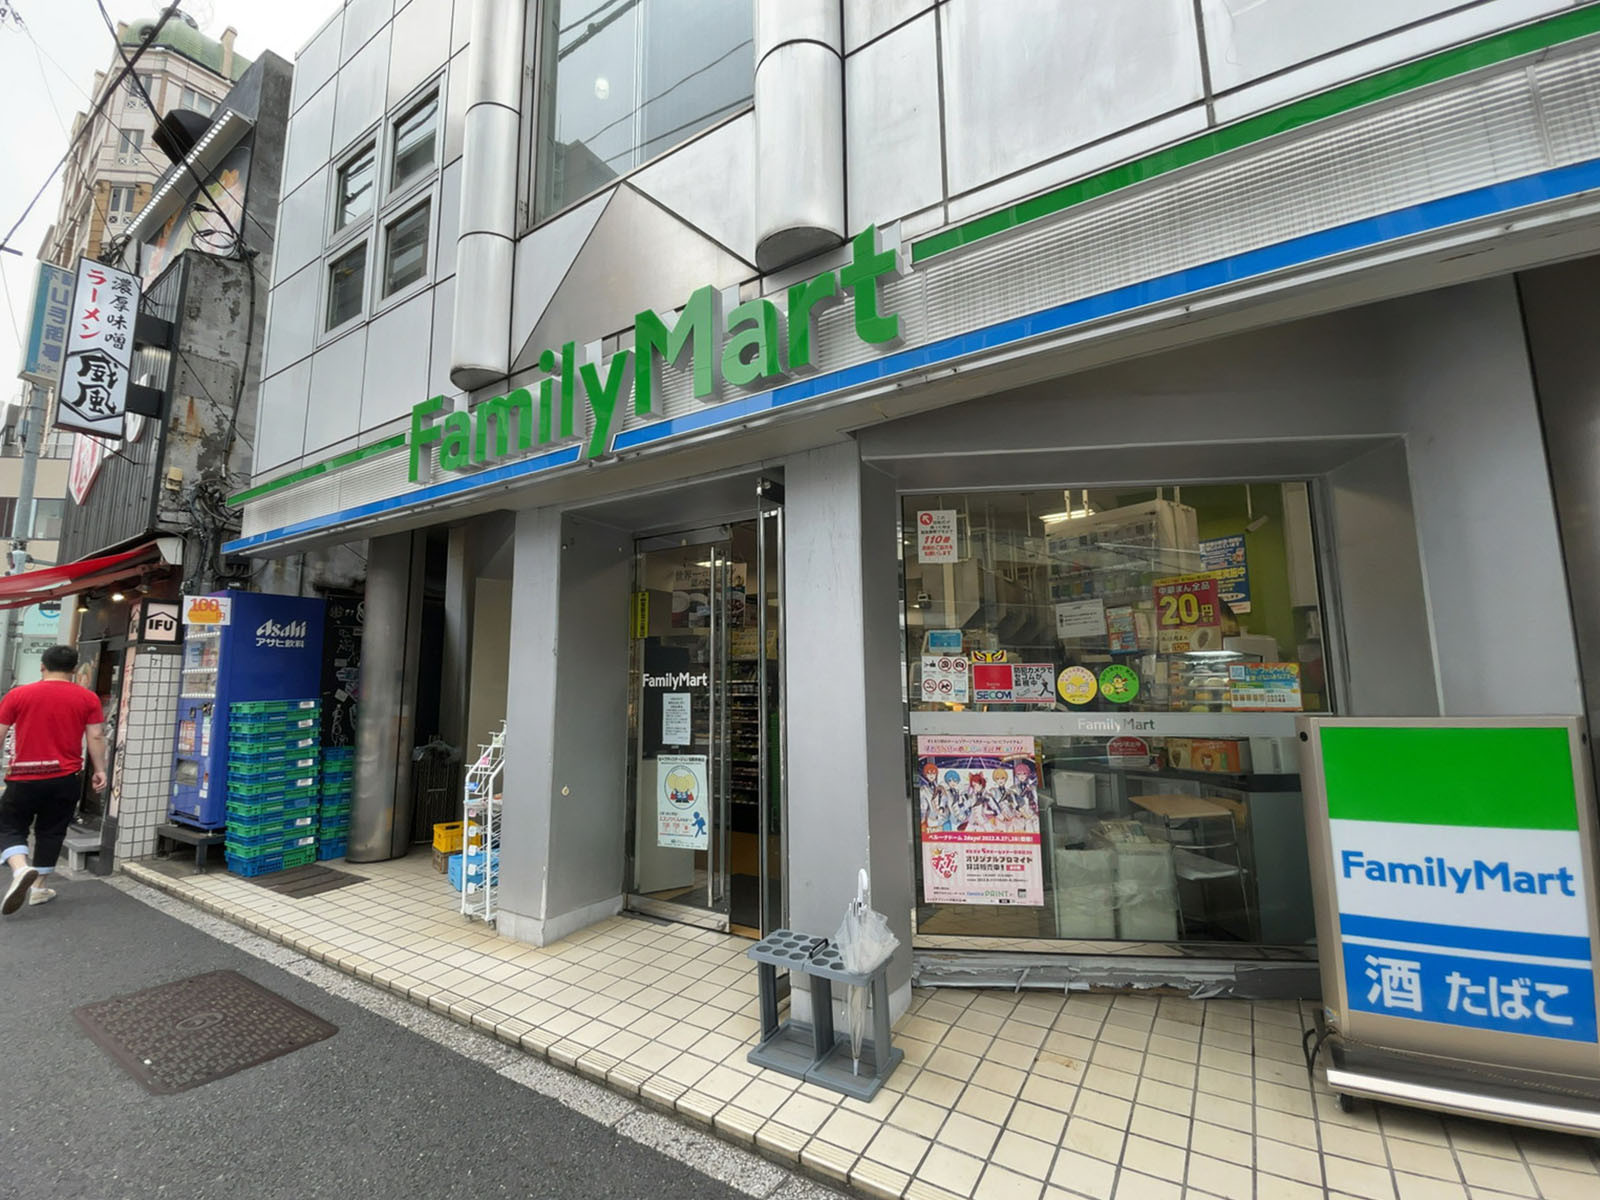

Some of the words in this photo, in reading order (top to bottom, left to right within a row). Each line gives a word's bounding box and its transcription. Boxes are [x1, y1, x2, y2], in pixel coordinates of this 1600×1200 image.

[79, 268, 107, 340] ラーメン
[105, 275, 134, 351] 濃厚味噌
[408, 223, 904, 484] FamilyMart
[148, 619, 174, 631] IFU
[256, 618, 307, 638] Asahi
[255, 637, 305, 648] アサヒ飲料
[642, 672, 708, 691] FamilyMart
[976, 690, 1012, 700] SECOM
[1078, 718, 1156, 733] FamilyMart
[1341, 850, 1576, 897] FamilyMart
[1364, 953, 1423, 1013] 酒
[1444, 970, 1574, 1026] たばこ
